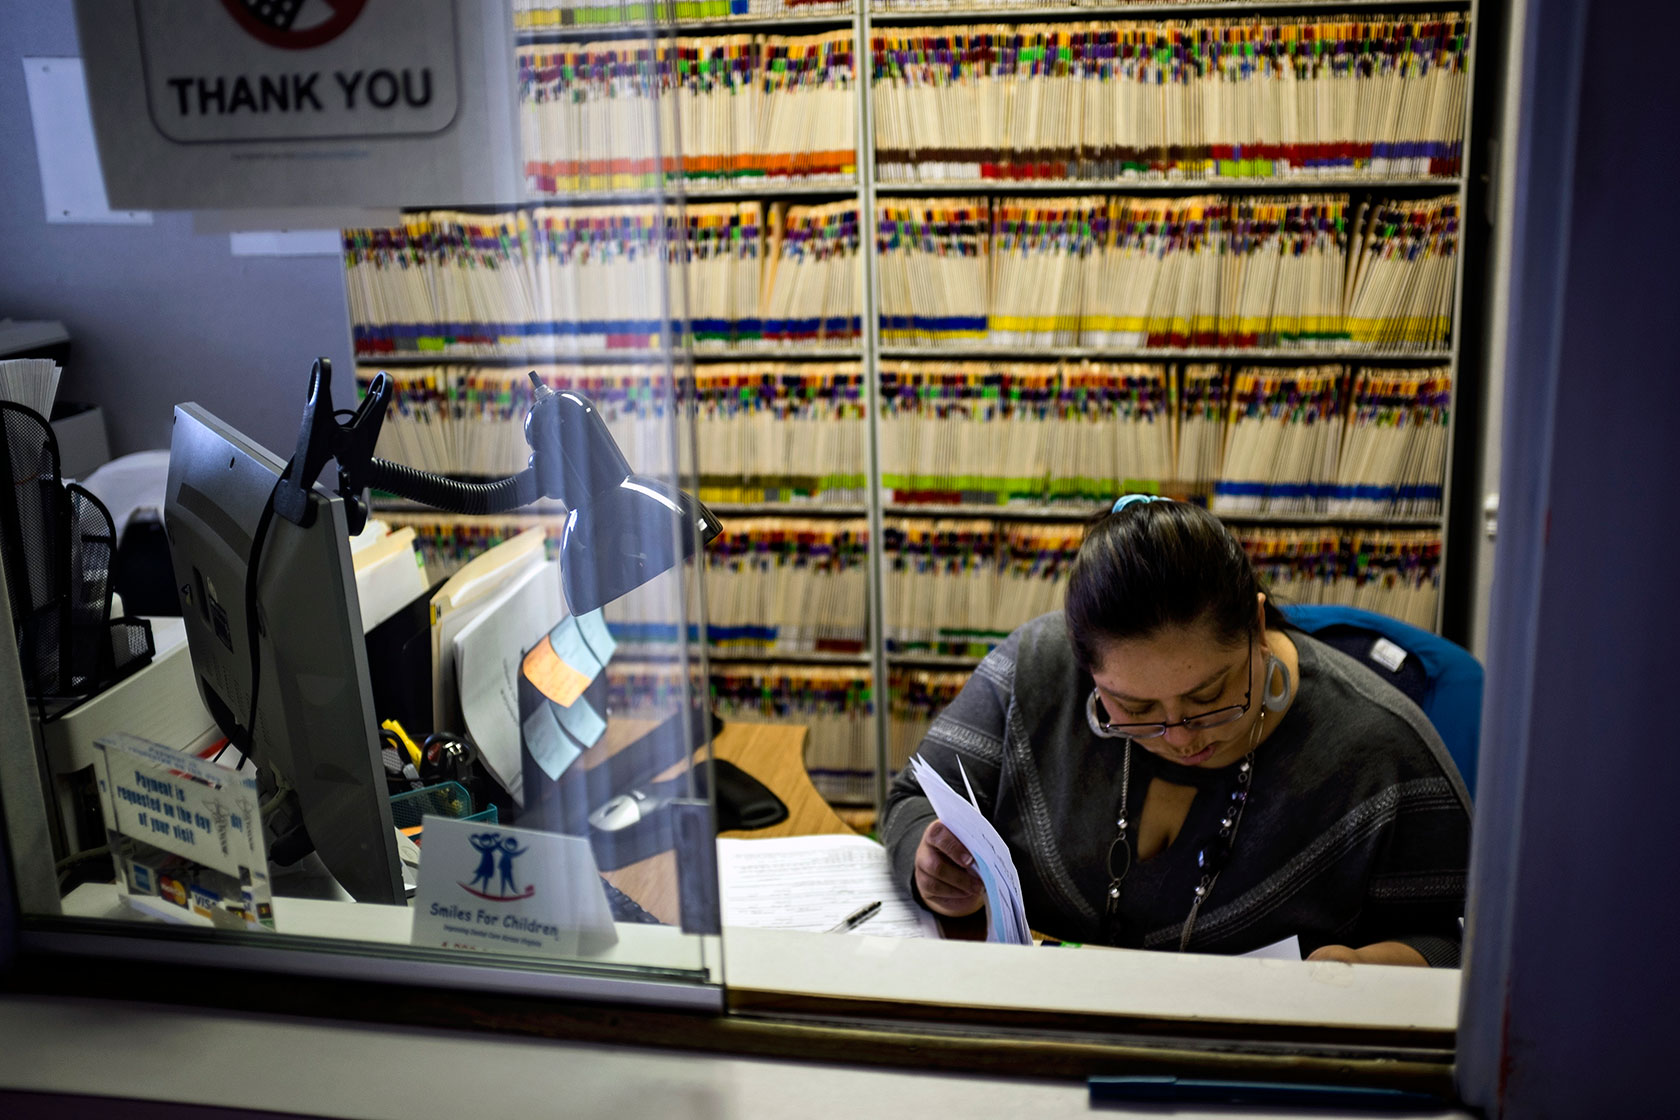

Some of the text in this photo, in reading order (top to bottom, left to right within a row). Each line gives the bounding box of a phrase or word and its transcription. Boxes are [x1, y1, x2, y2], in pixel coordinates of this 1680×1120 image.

[166, 68, 431, 116] THANK YOU
[134, 770, 185, 802] Payment is
[116, 786, 161, 813] requested
[163, 803, 175, 818] on
[176, 805, 193, 825] the
[194, 813, 211, 834] day
[138, 812, 195, 845] of your visit
[430, 902, 559, 937] Smiles For Children
